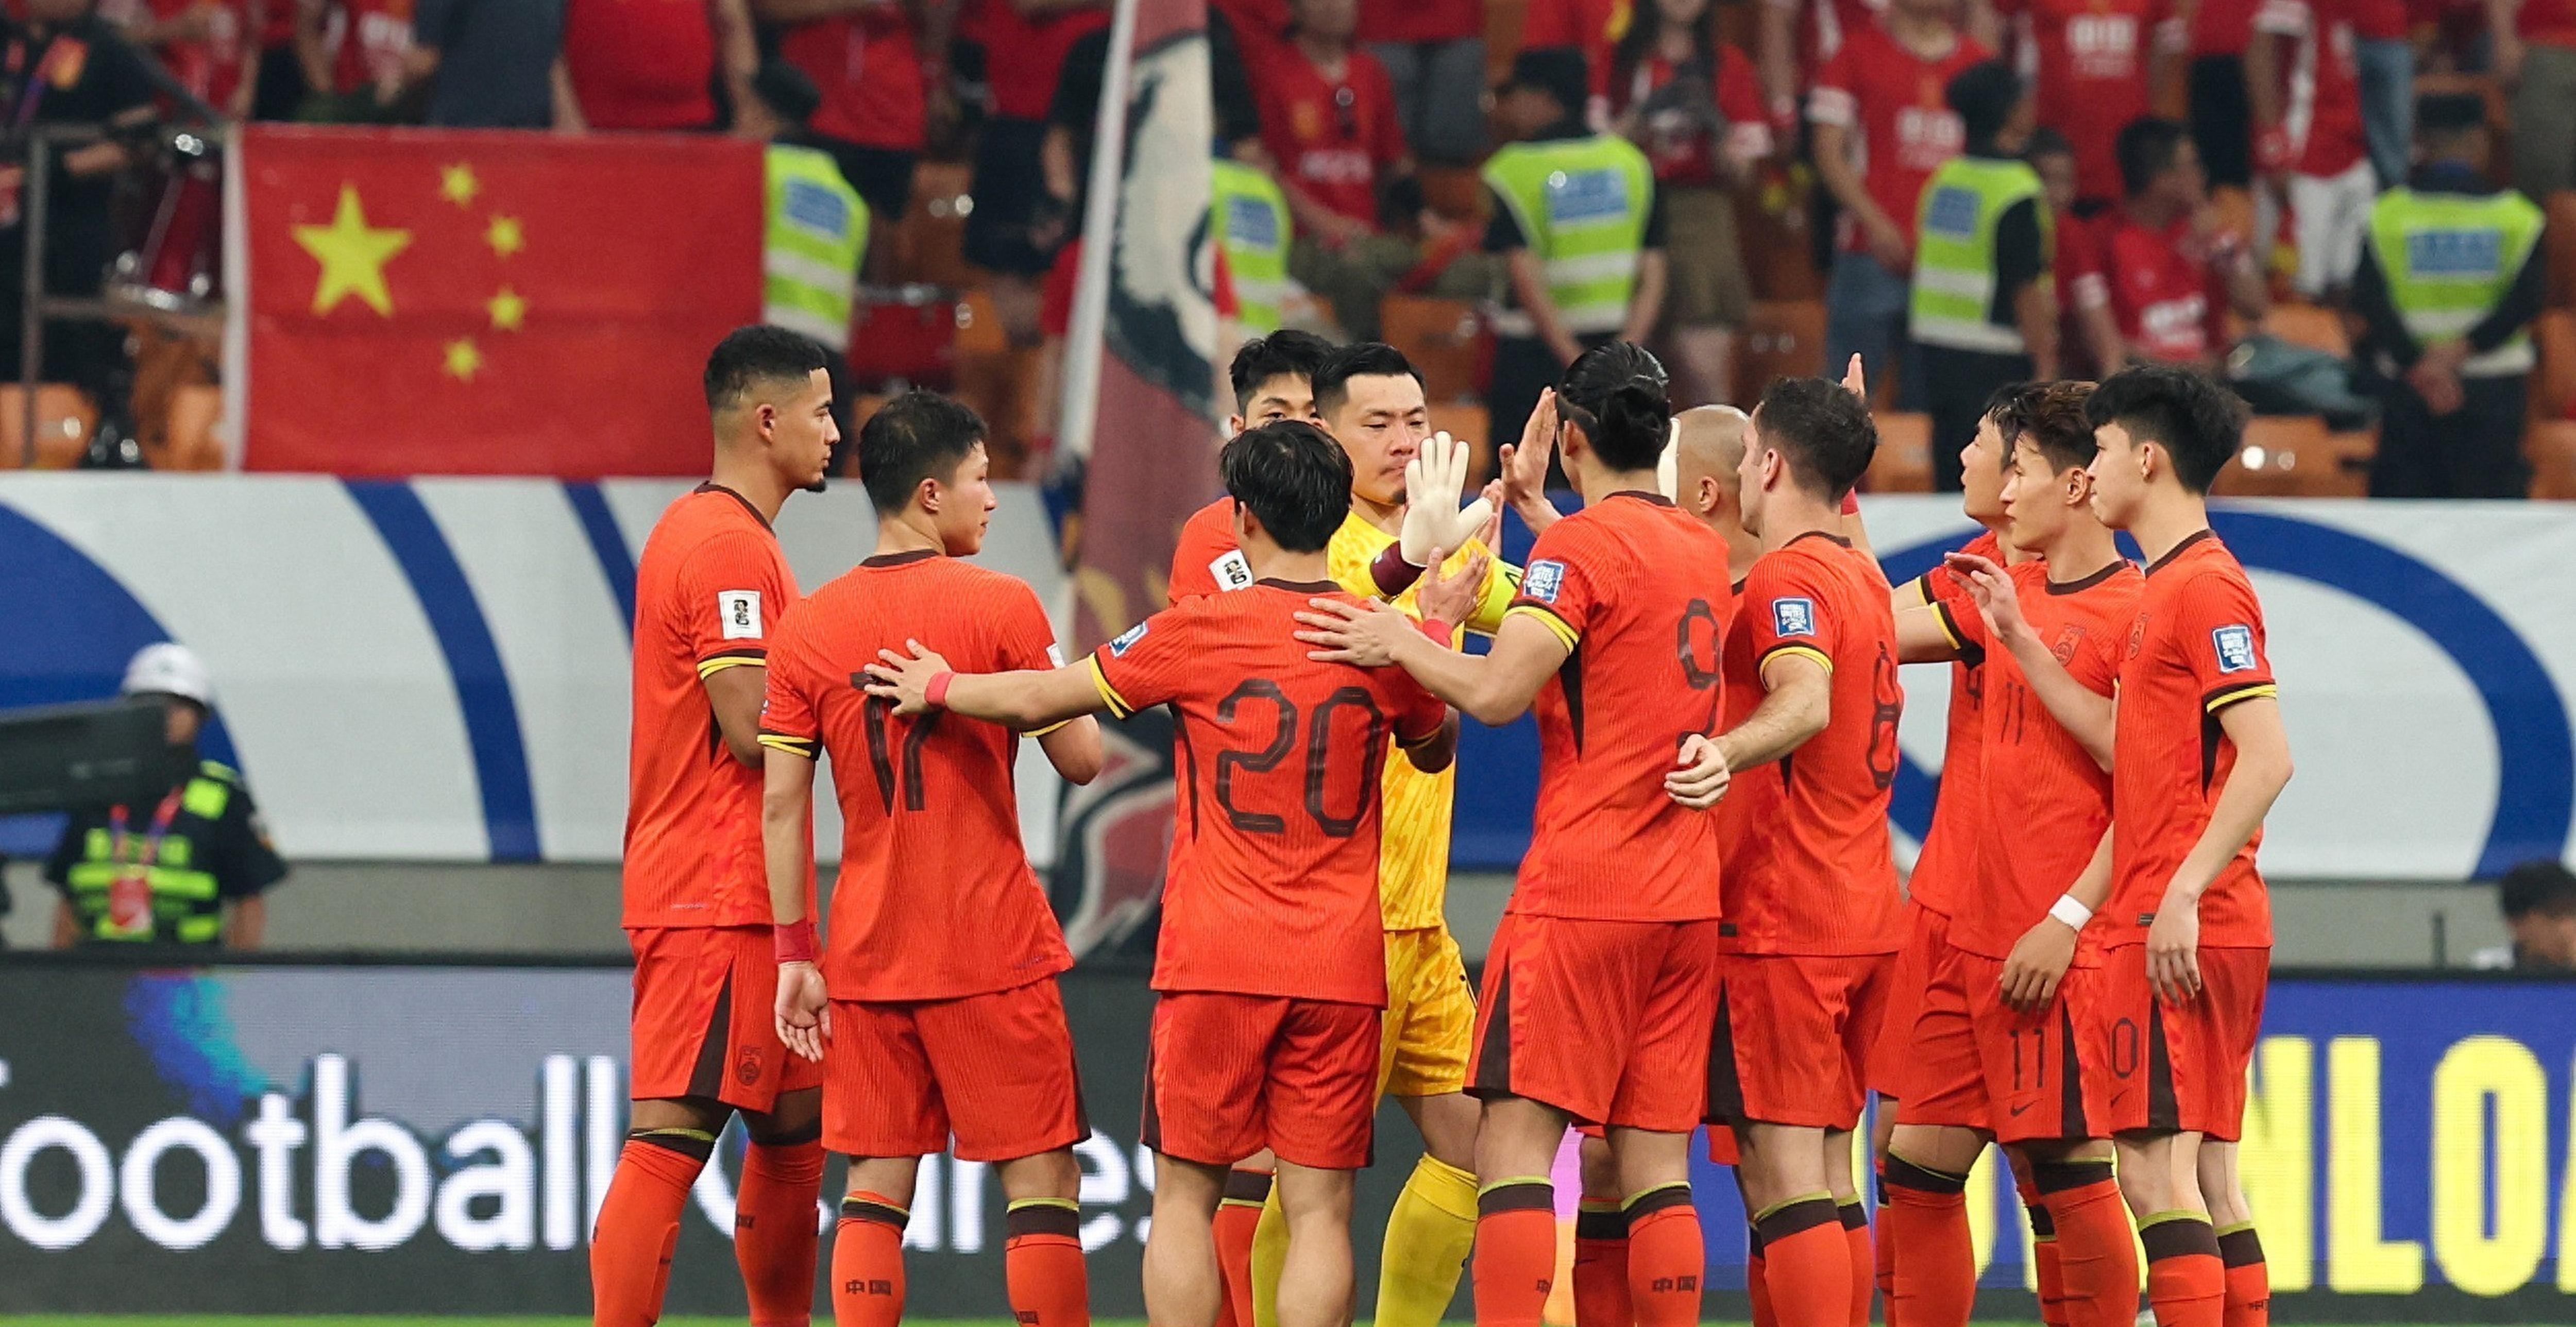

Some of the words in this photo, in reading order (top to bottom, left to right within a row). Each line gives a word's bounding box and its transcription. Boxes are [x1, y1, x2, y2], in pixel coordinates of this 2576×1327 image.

[1676, 598, 1720, 749] 9
[1866, 641, 1902, 790] 8
[2001, 680, 2025, 746] 11
[1215, 678, 1384, 838] 20
[2010, 1028, 2043, 1091] 11
[0, 1053, 621, 1252] ootball
[845, 1280, 891, 1296] 中国
